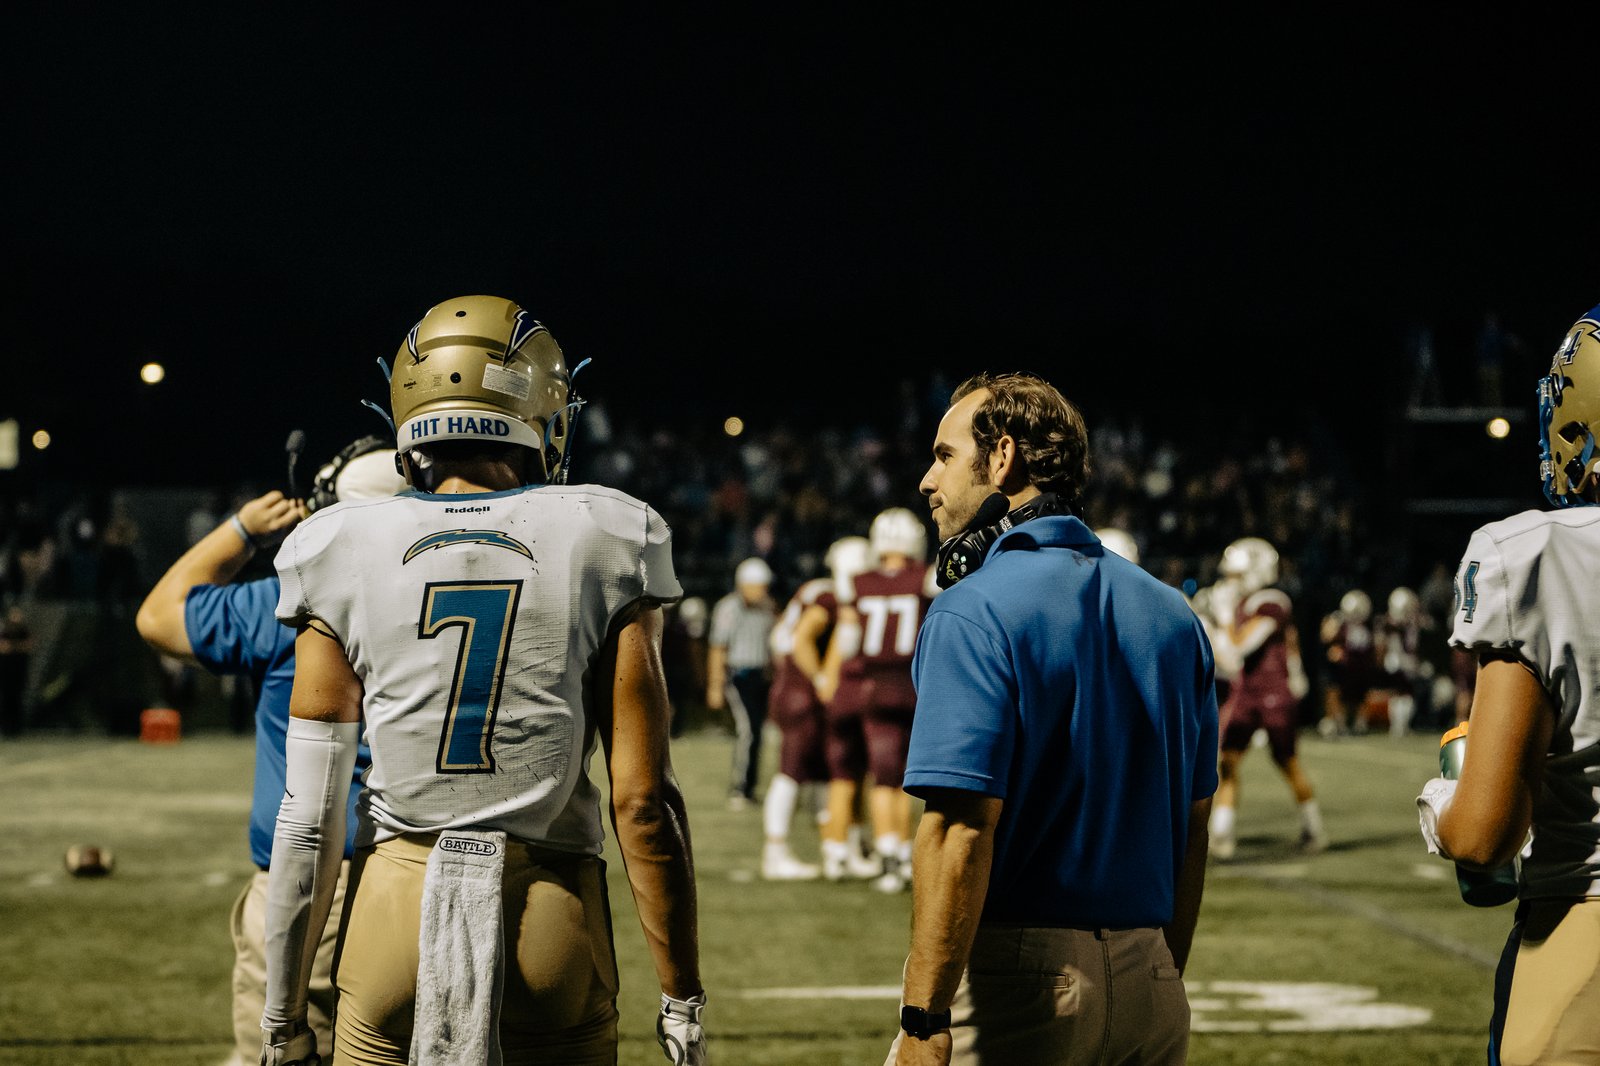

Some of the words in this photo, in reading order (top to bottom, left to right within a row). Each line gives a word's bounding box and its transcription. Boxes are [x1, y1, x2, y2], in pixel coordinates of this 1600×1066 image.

[411, 418, 440, 440] HIT
[447, 416, 510, 437] HARD
[444, 506, 490, 514] Riddell
[856, 594, 919, 657] 77
[417, 579, 524, 775] 7
[444, 840, 492, 854] BATTLE
